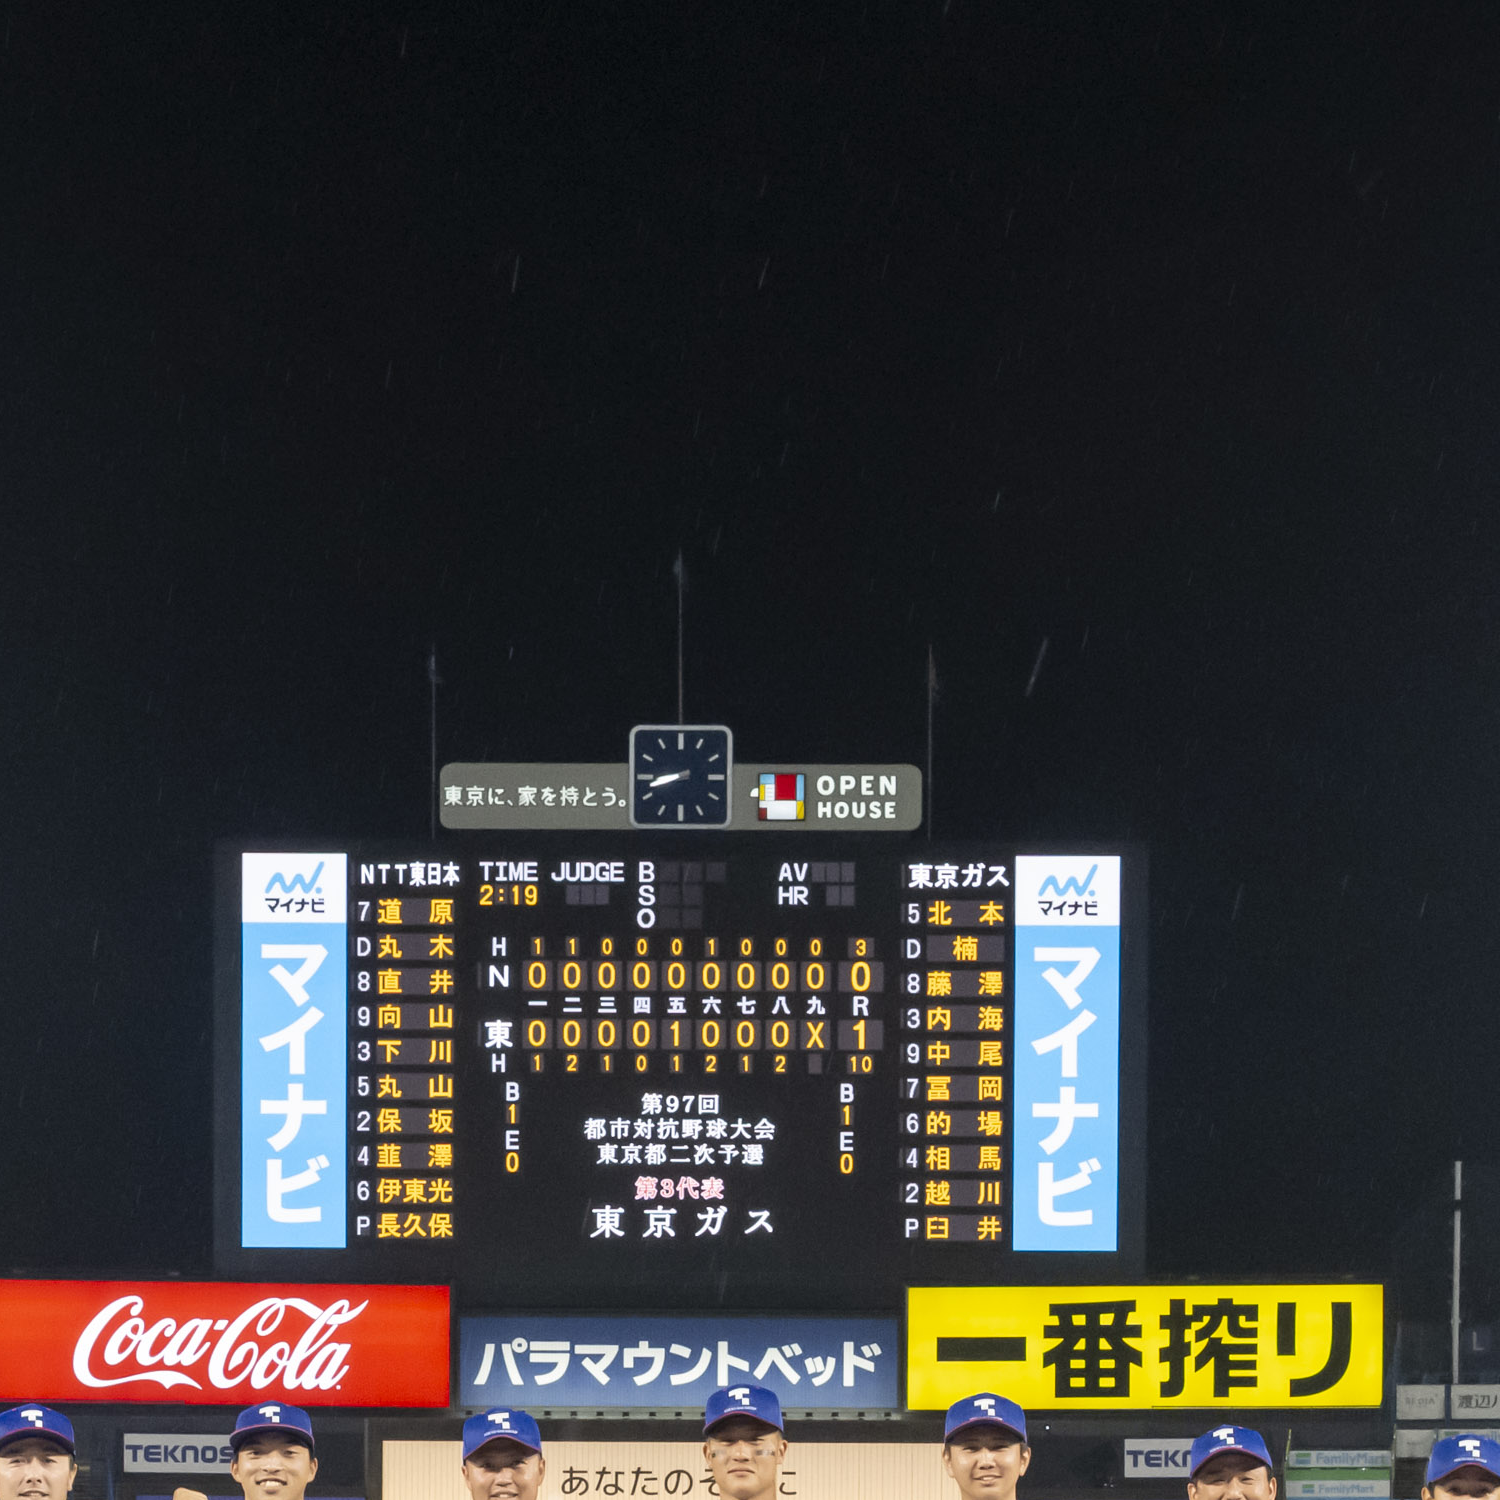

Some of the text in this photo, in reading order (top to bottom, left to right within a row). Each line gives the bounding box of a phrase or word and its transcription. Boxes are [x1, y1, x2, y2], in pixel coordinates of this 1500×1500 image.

[445, 785, 626, 807] 東京に、家を持とう。
[817, 776, 896, 795] OPEN
[818, 801, 895, 818] HOUSE
[361, 861, 459, 887] NTT東日本
[479, 862, 538, 881] TIME
[551, 862, 624, 882] JUDGE
[639, 862, 655, 882] B
[779, 863, 808, 881] AV
[909, 863, 1009, 889] 東京ガス
[265, 898, 324, 913] マイナビ
[480, 885, 537, 905] 2:19
[639, 885, 655, 905] S
[779, 886, 808, 905] HR
[358, 898, 453, 924] 7 道原
[908, 901, 1004, 925] 5 北本
[1038, 901, 1097, 915] マイナビ
[357, 934, 453, 958] D 丸木
[907, 936, 978, 961] D 楠
[358, 968, 453, 994] 8 直井
[908, 971, 1003, 996] 8 藤澤
[358, 1004, 452, 1028] 9 向山
[907, 1006, 1003, 1031] 3 内海
[485, 1020, 865, 1049] 東 0 0 0 0 1 0 0 0 X 1
[358, 1040, 451, 1063] 3 下川
[907, 1041, 1002, 1066] 9 中尾
[259, 944, 329, 1224] マイナビ
[358, 1074, 452, 1098] 5 丸山
[907, 1079, 918, 1098] 7
[1031, 946, 1101, 1227] マイナビ
[642, 1093, 719, 1114] 第97回
[357, 1108, 453, 1133] 2 保坂
[584, 1117, 775, 1140] 都市対抗野球大会
[907, 1111, 1002, 1136] 6 的場
[358, 1146, 369, 1165] 4
[597, 1143, 763, 1165] 東京都二次予選
[907, 1146, 1001, 1170] 4 相馬
[357, 1178, 452, 1203] 6 伊東光
[635, 1176, 724, 1200] 第3代表
[906, 1180, 1000, 1205] 2 越川
[357, 1213, 453, 1238] P 長久保
[590, 1205, 773, 1238] 東京ガス
[906, 1216, 1002, 1240] P 臼井
[72, 1295, 369, 1391] Coca-Cola
[936, 1298, 1353, 1399] 一番搾り
[473, 1338, 882, 1388] パラマウントベッド
[1315, 1450, 1387, 1467] FamilyMart
[560, 1465, 798, 1497] あなたのそに
[1318, 1483, 1375, 1496] FamilyMart
